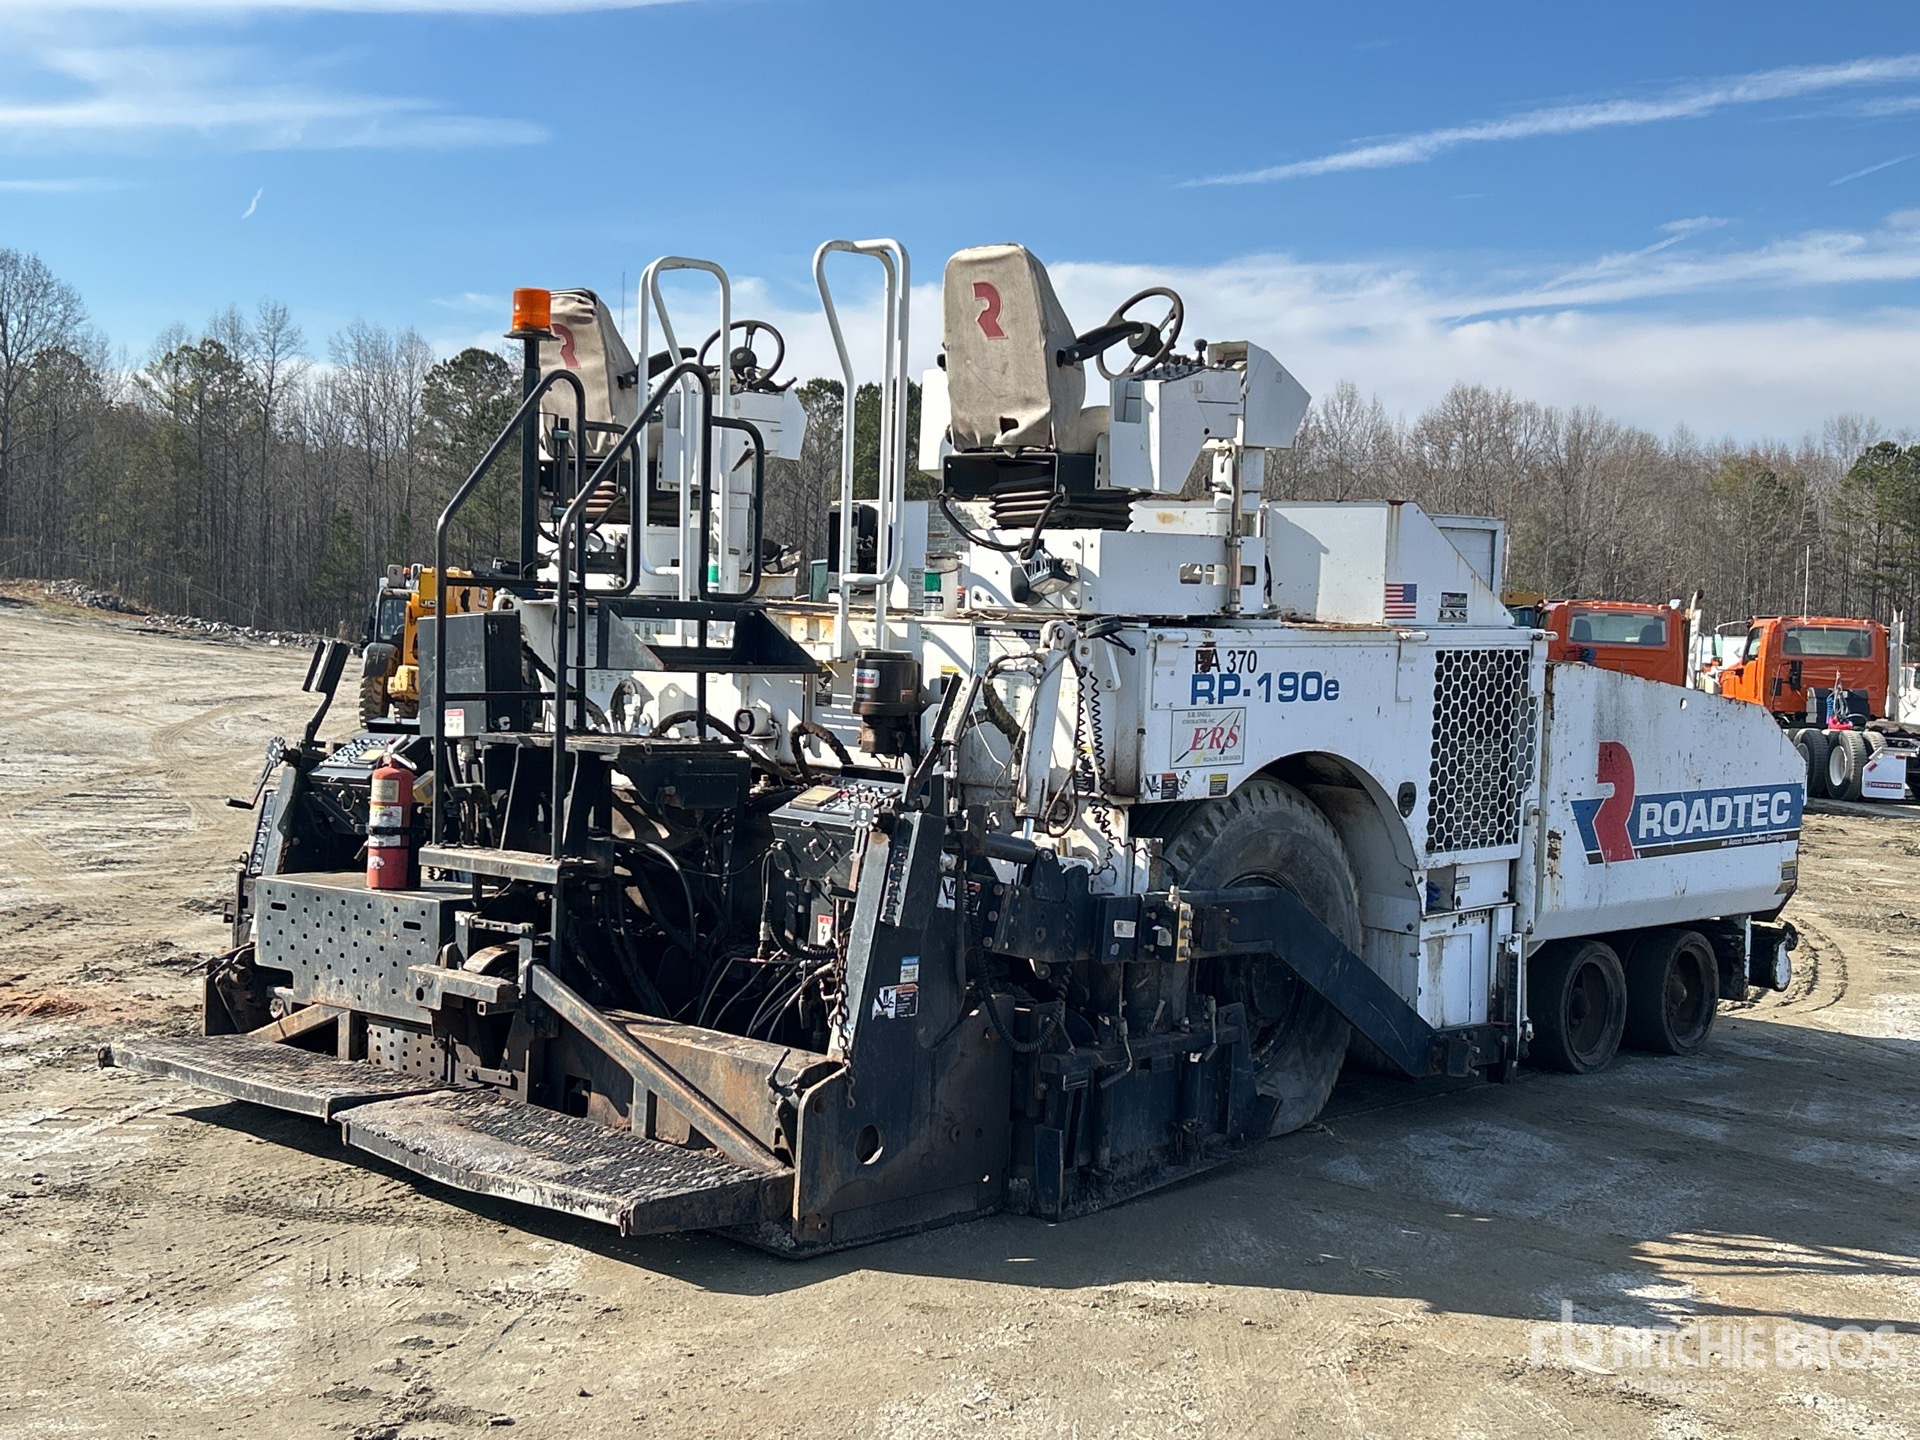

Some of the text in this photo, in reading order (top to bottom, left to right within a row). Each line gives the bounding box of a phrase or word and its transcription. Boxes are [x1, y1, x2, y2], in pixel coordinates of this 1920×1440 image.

[1226, 649, 1258, 674] 370
[1190, 671, 1340, 705] RP-190e
[1189, 724, 1241, 751] ERS
[1638, 791, 1792, 839] ROADTEC
